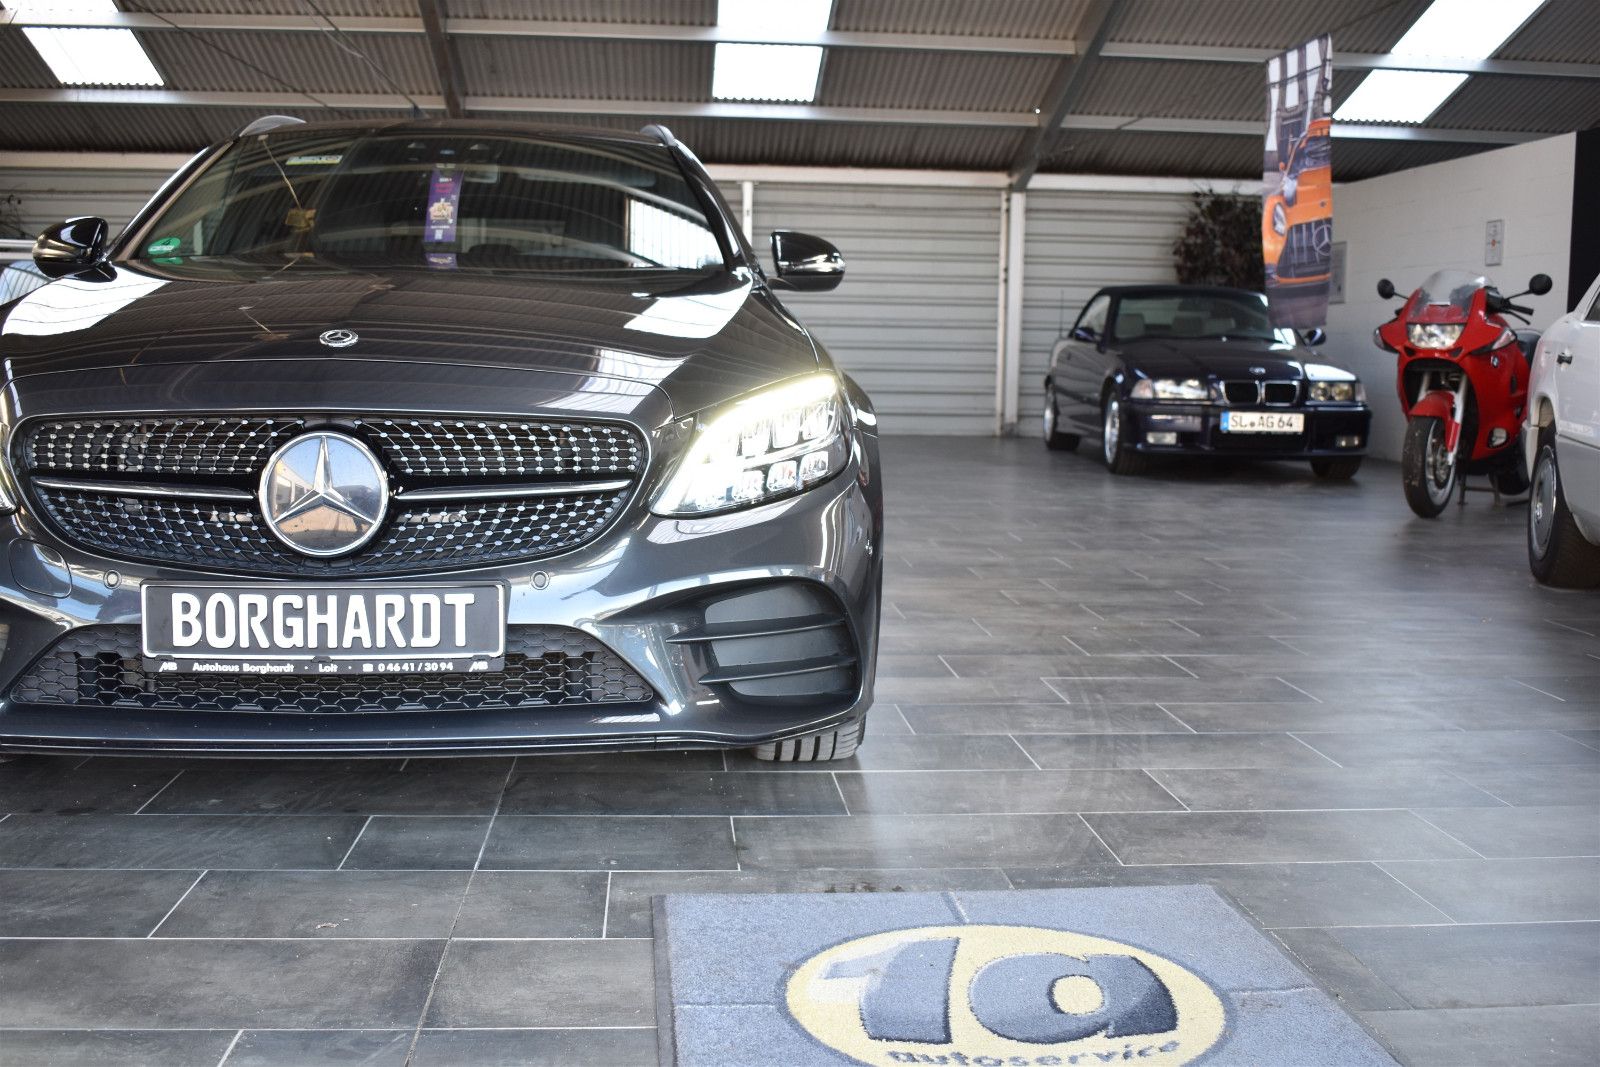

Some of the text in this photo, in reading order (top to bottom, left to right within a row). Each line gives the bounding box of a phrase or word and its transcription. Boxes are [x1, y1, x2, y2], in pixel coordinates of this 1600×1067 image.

[1231, 415, 1293, 428] SL AG 64
[171, 592, 475, 649] BORGHARDT
[192, 662, 240, 672] Autohaus
[242, 662, 295, 674] Borghardt
